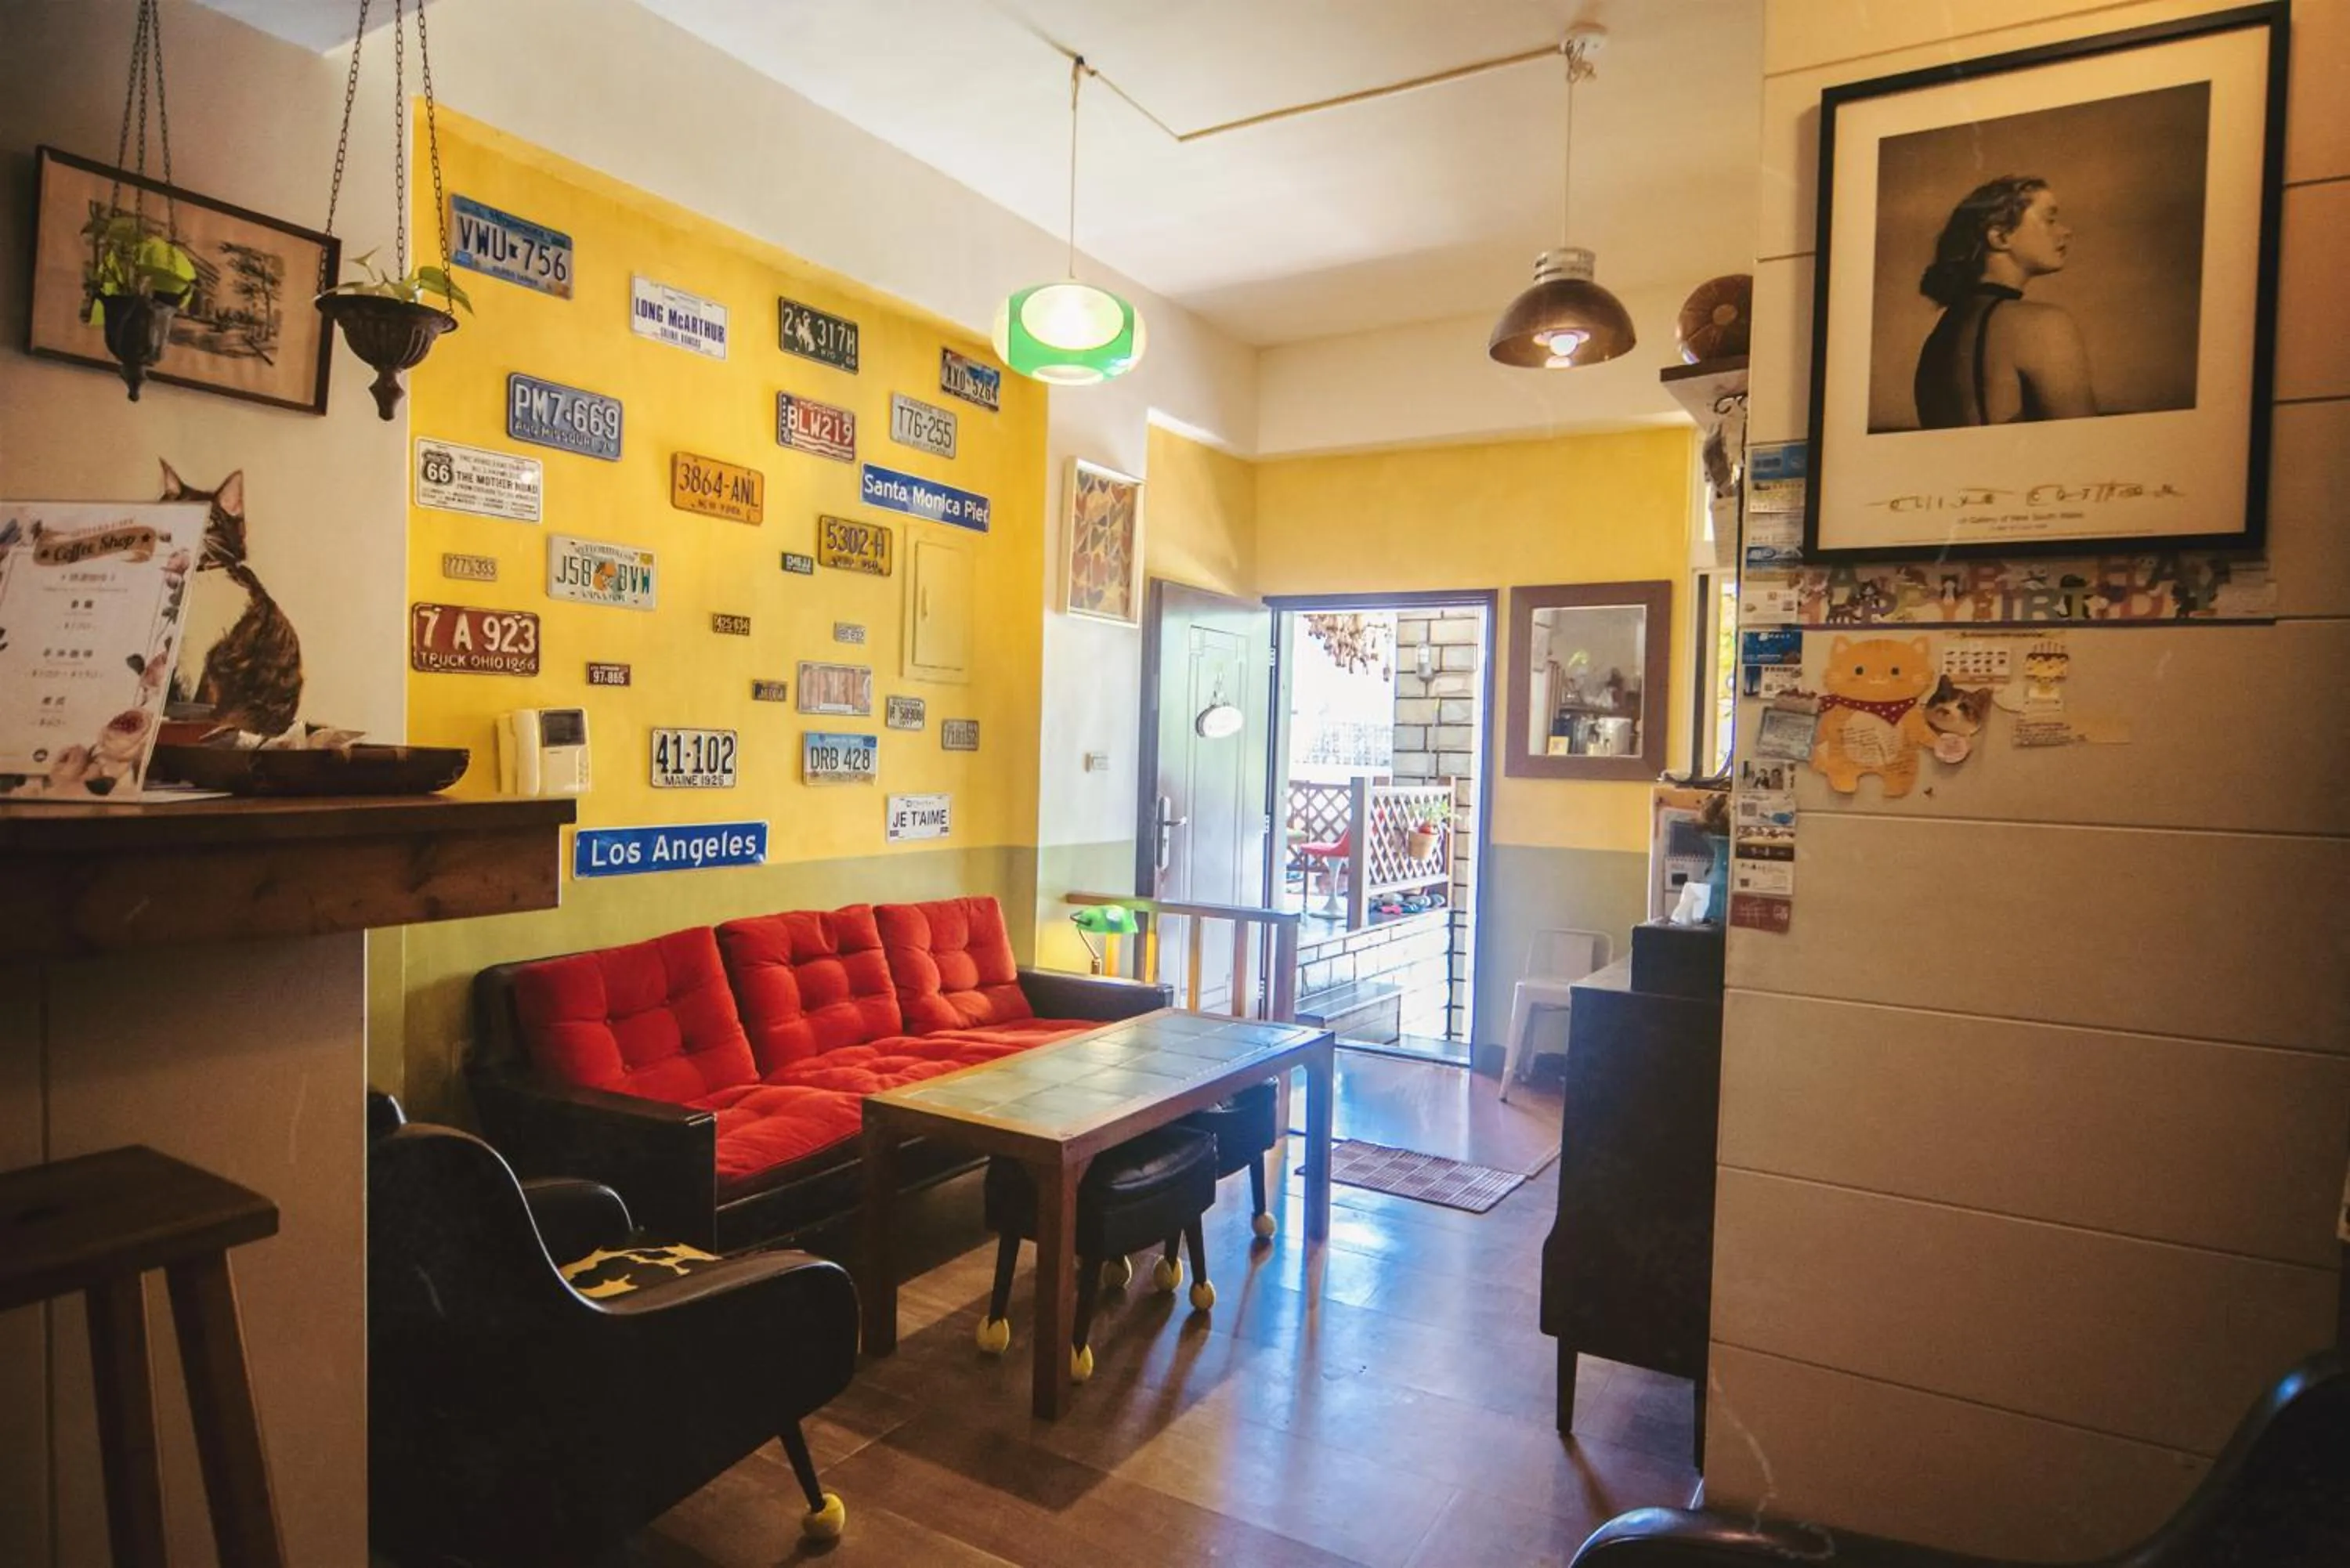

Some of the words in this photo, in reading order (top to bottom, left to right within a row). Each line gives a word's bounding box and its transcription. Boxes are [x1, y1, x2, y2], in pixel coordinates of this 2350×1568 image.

[635, 297, 663, 323] LONG
[668, 308, 725, 344] McARTHUR
[426, 462, 451, 483] 66
[457, 470, 474, 483] THE
[864, 473, 907, 502] Santa
[913, 486, 960, 516] Monica
[99, 534, 136, 550] Shop
[419, 610, 439, 649] 7
[452, 612, 472, 652] A
[483, 616, 536, 654] 923
[420, 652, 466, 667] TRUCK
[471, 654, 504, 668] OHIO
[810, 746, 839, 770] DRB
[844, 746, 870, 771] 428
[665, 775, 698, 786] MAINE
[892, 811, 907, 828] JE
[591, 838, 642, 867] Los
[652, 830, 756, 866] Angeles
